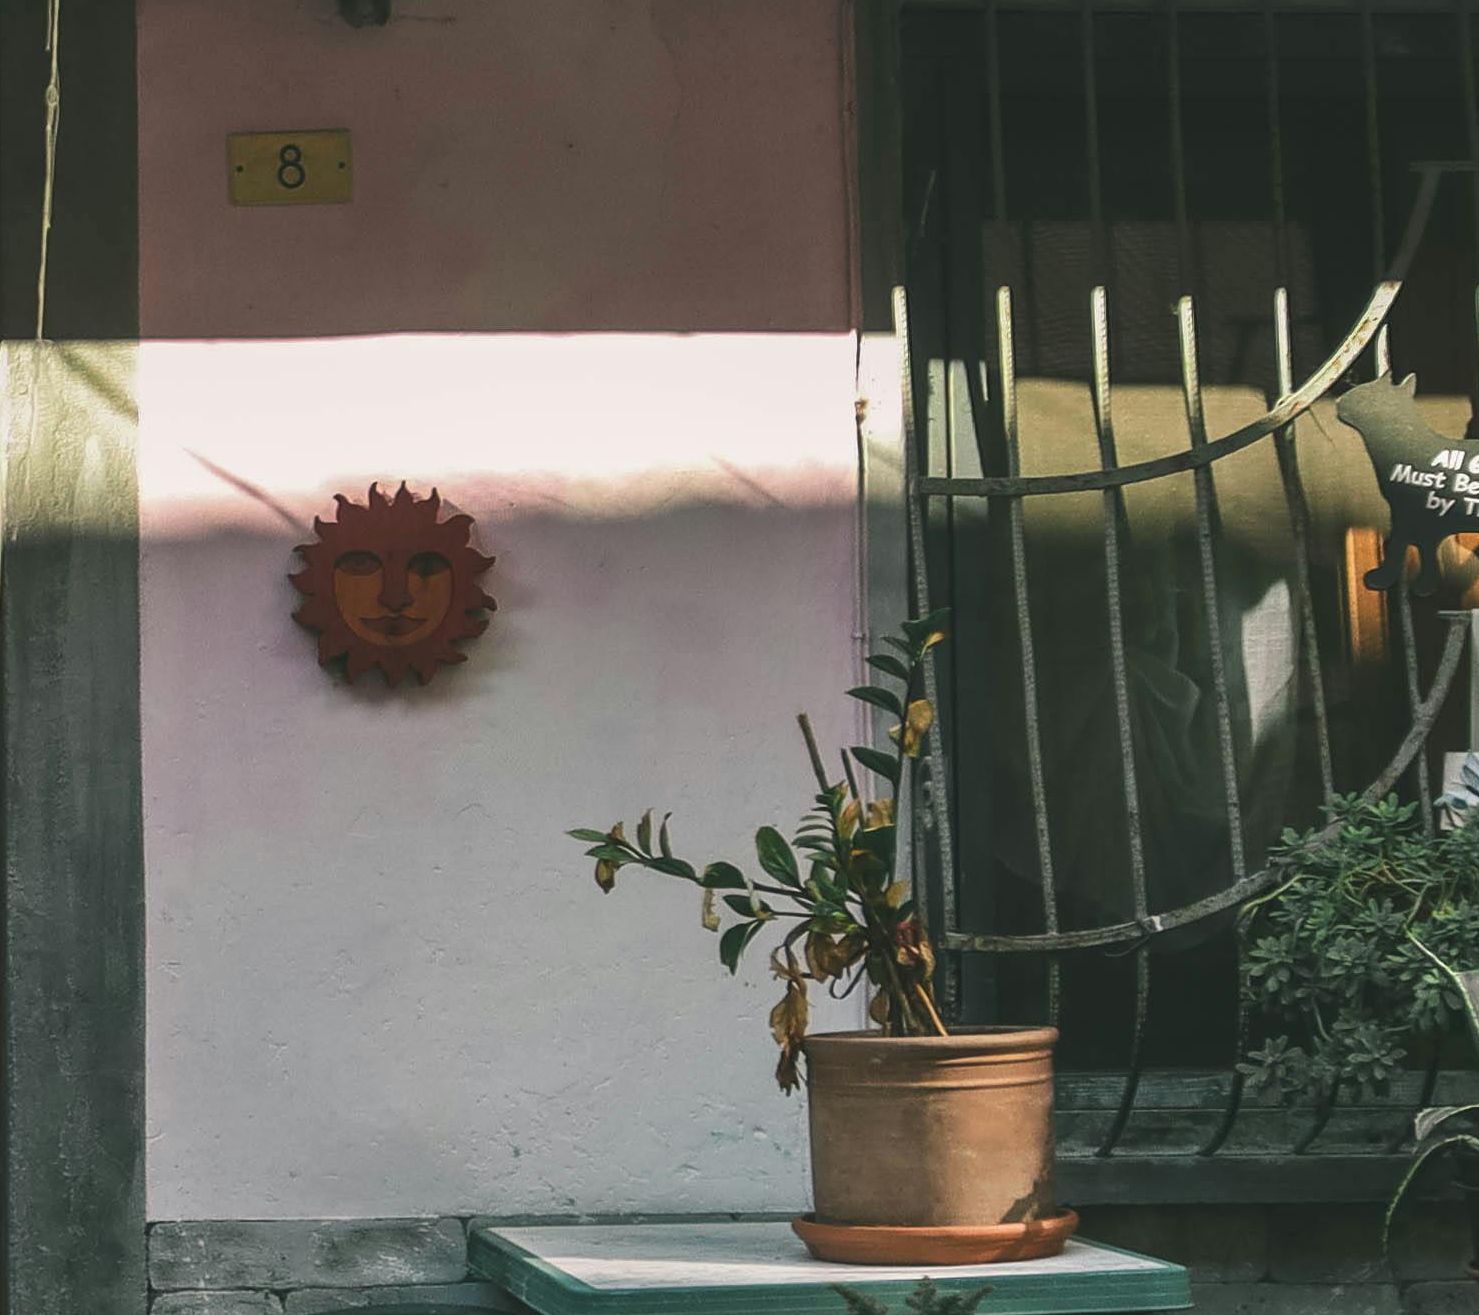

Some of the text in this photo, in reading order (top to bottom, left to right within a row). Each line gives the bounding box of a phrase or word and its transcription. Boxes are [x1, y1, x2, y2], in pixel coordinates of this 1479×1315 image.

[277, 144, 306, 189] 8
[1431, 449, 1465, 470] All
[1390, 463, 1447, 488] Must
[1426, 491, 1455, 516] by
